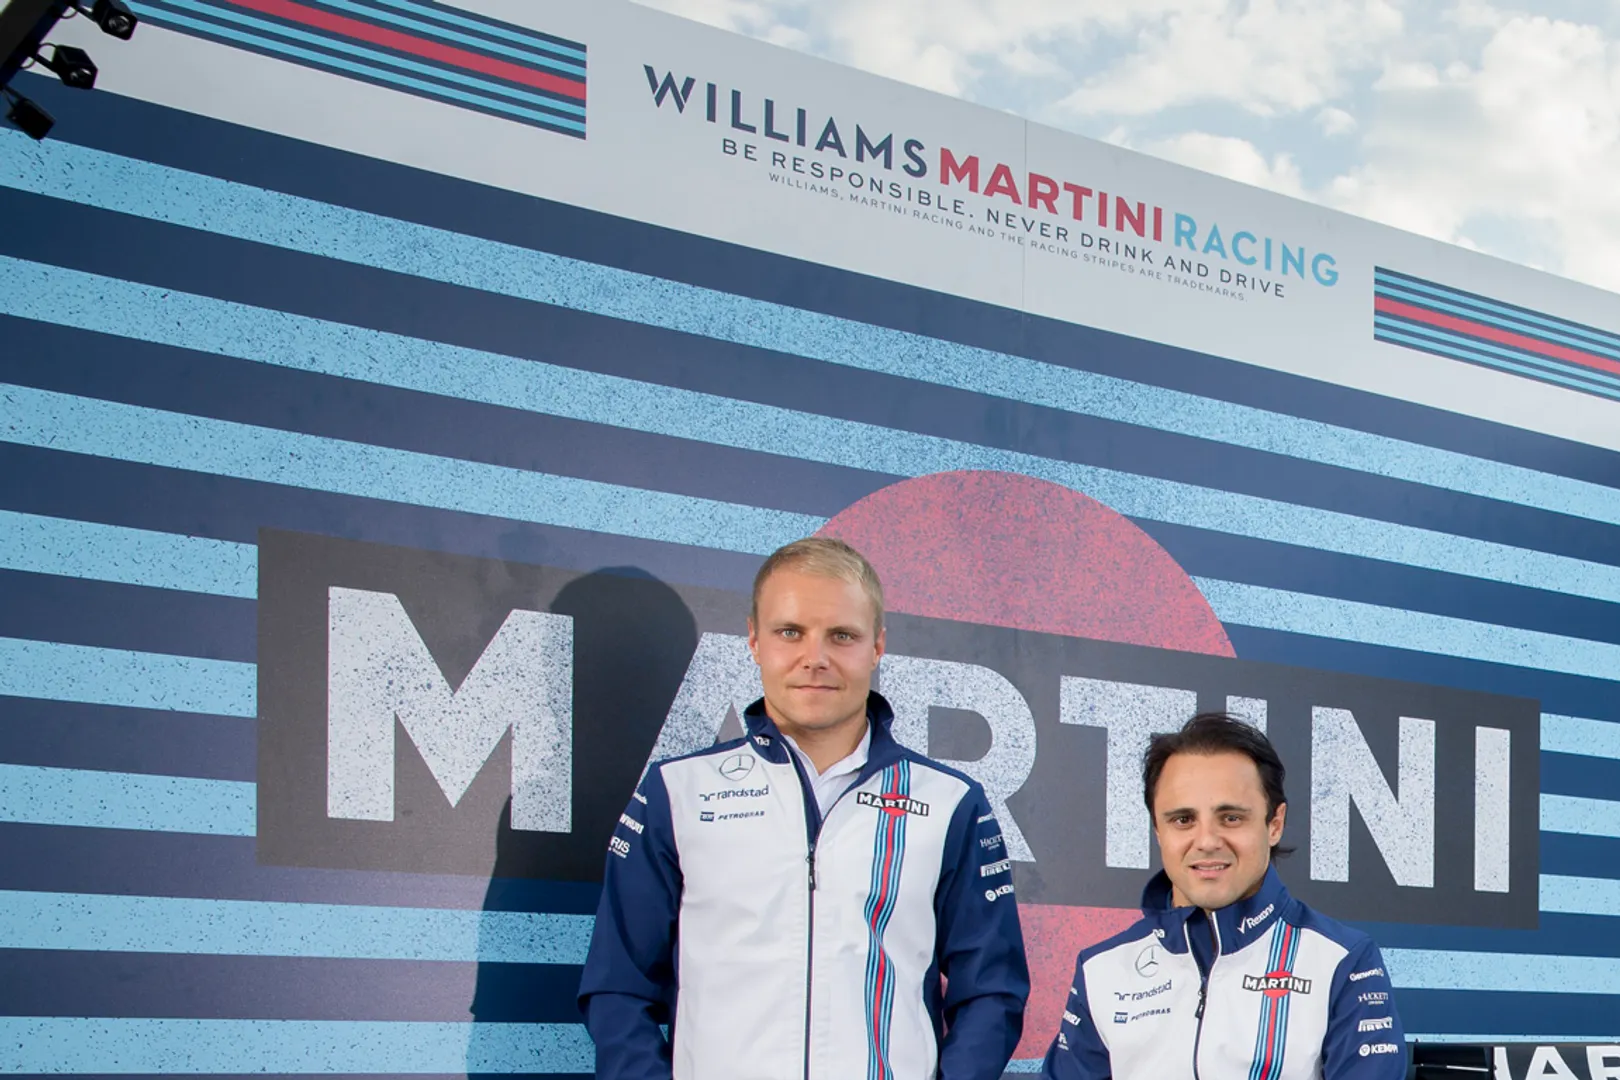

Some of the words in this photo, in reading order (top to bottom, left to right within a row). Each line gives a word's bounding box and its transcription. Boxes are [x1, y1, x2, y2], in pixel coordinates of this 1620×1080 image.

[643, 64, 928, 178] WILLIAMS
[940, 147, 1163, 242] MARTINI
[1174, 212, 1340, 287] RACING
[722, 138, 758, 162] BE
[773, 151, 975, 218] RESPONSIBLE.
[987, 208, 1069, 242] NEVER
[1081, 233, 1154, 264] DRINK
[1164, 256, 1209, 277] AND
[1220, 269, 1285, 298] DRIVE
[769, 172, 844, 201] WILLIAMS,
[850, 194, 908, 216] MARTINI
[913, 210, 964, 231] RACING
[968, 225, 995, 238] AND
[1000, 232, 1025, 246] THE
[1031, 239, 1078, 260] RACING
[1083, 253, 1135, 274] STRIPES
[1139, 268, 1162, 280] ARE
[717, 784, 769, 800] randstad
[858, 793, 927, 816] MARTINI
[610, 835, 630, 853] RIS
[1132, 979, 1172, 1000] randstad
[1243, 975, 1310, 993] MARTINI
[1131, 1008, 1171, 1021] PETROBRAS
